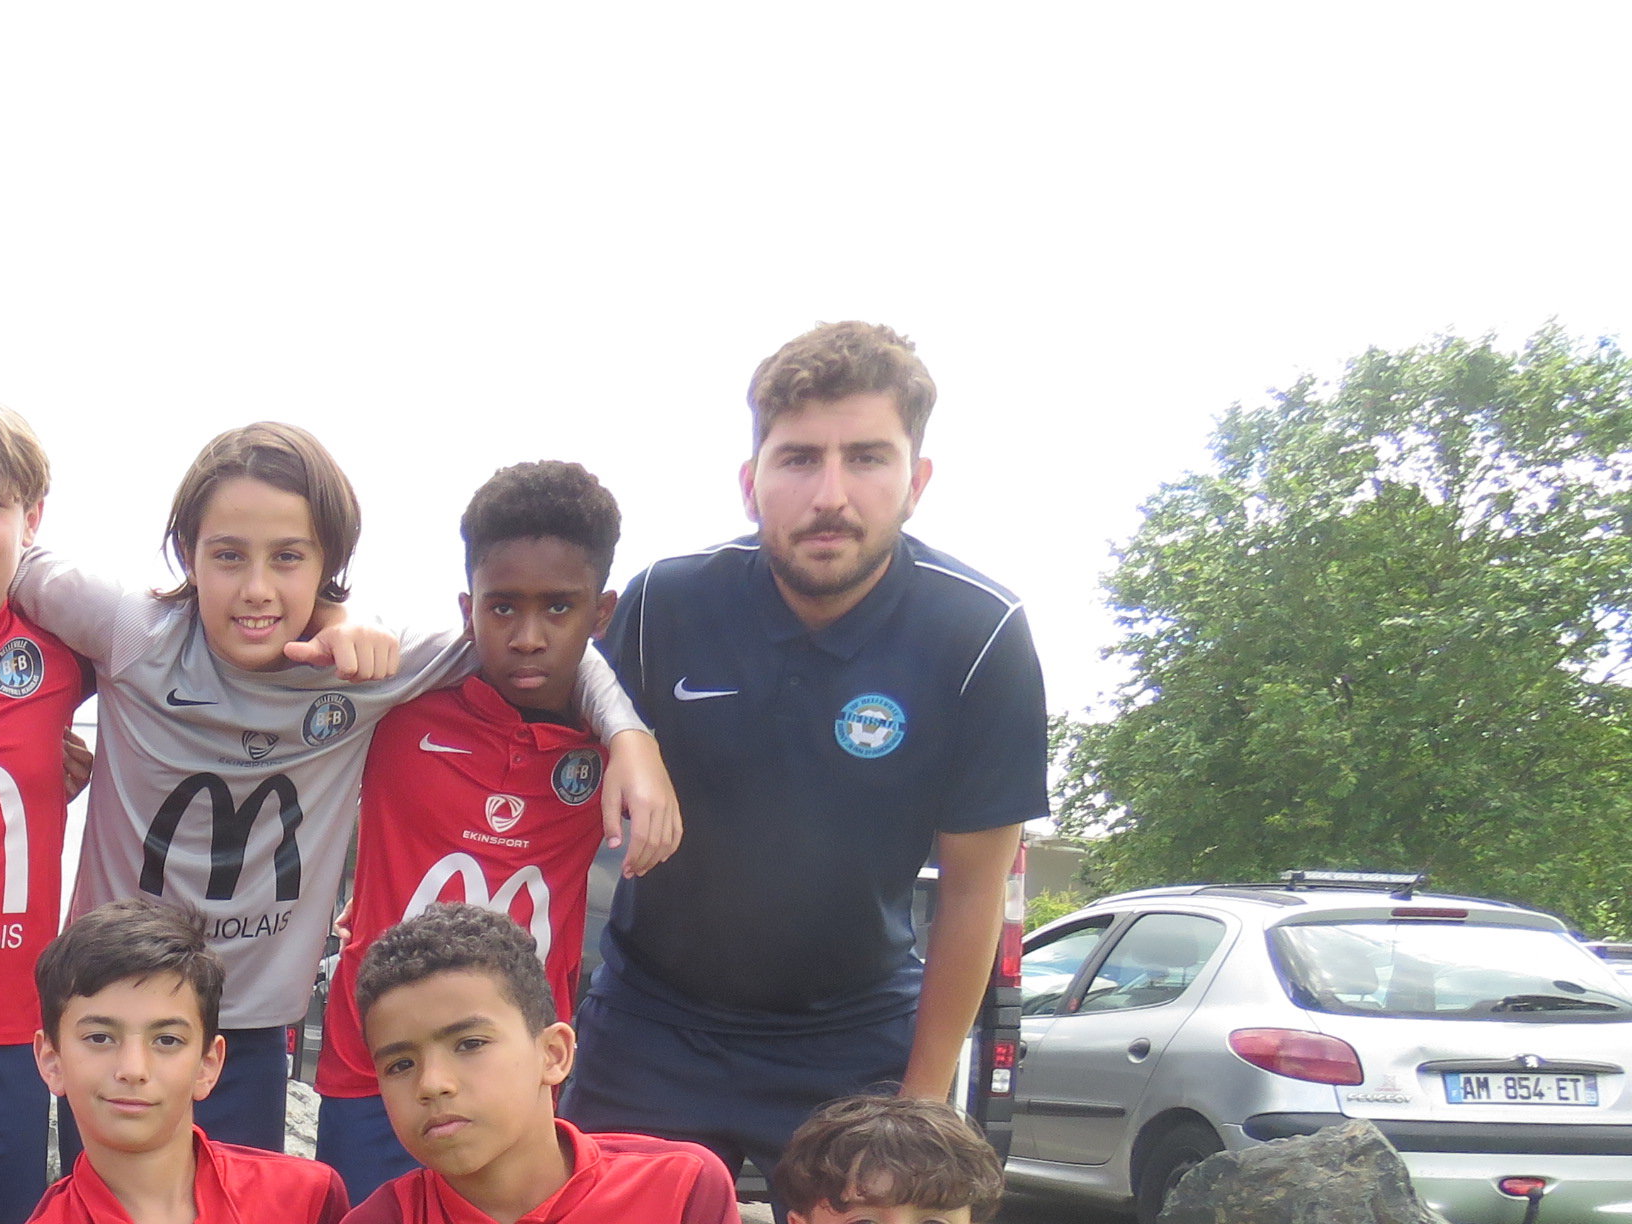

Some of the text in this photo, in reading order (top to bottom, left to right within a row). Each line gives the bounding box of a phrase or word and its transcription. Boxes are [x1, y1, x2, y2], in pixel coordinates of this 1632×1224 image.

[2, 655, 28, 675] BFB
[316, 711, 342, 726] BFB
[462, 830, 530, 849] EKINSPORT
[207, 910, 292, 939] JOLAIS
